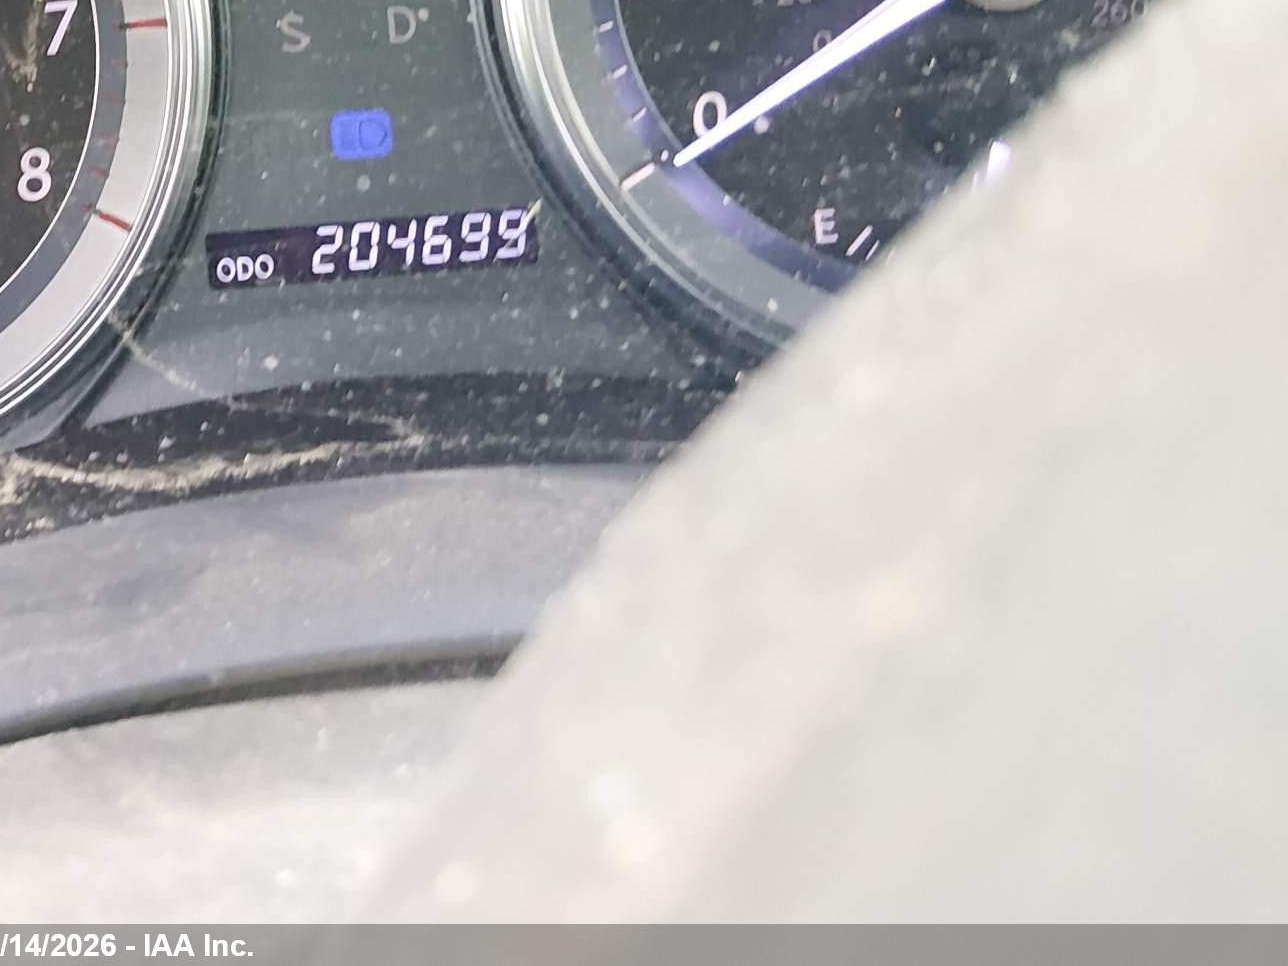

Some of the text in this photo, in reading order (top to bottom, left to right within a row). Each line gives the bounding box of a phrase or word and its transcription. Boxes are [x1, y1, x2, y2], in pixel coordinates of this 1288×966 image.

[44, 0, 79, 56] 7
[280, 13, 311, 53] S
[386, 5, 416, 45] D
[692, 90, 729, 138] 0
[17, 147, 51, 202] 8
[216, 208, 527, 283] ODO 204699
[814, 207, 839, 244] E
